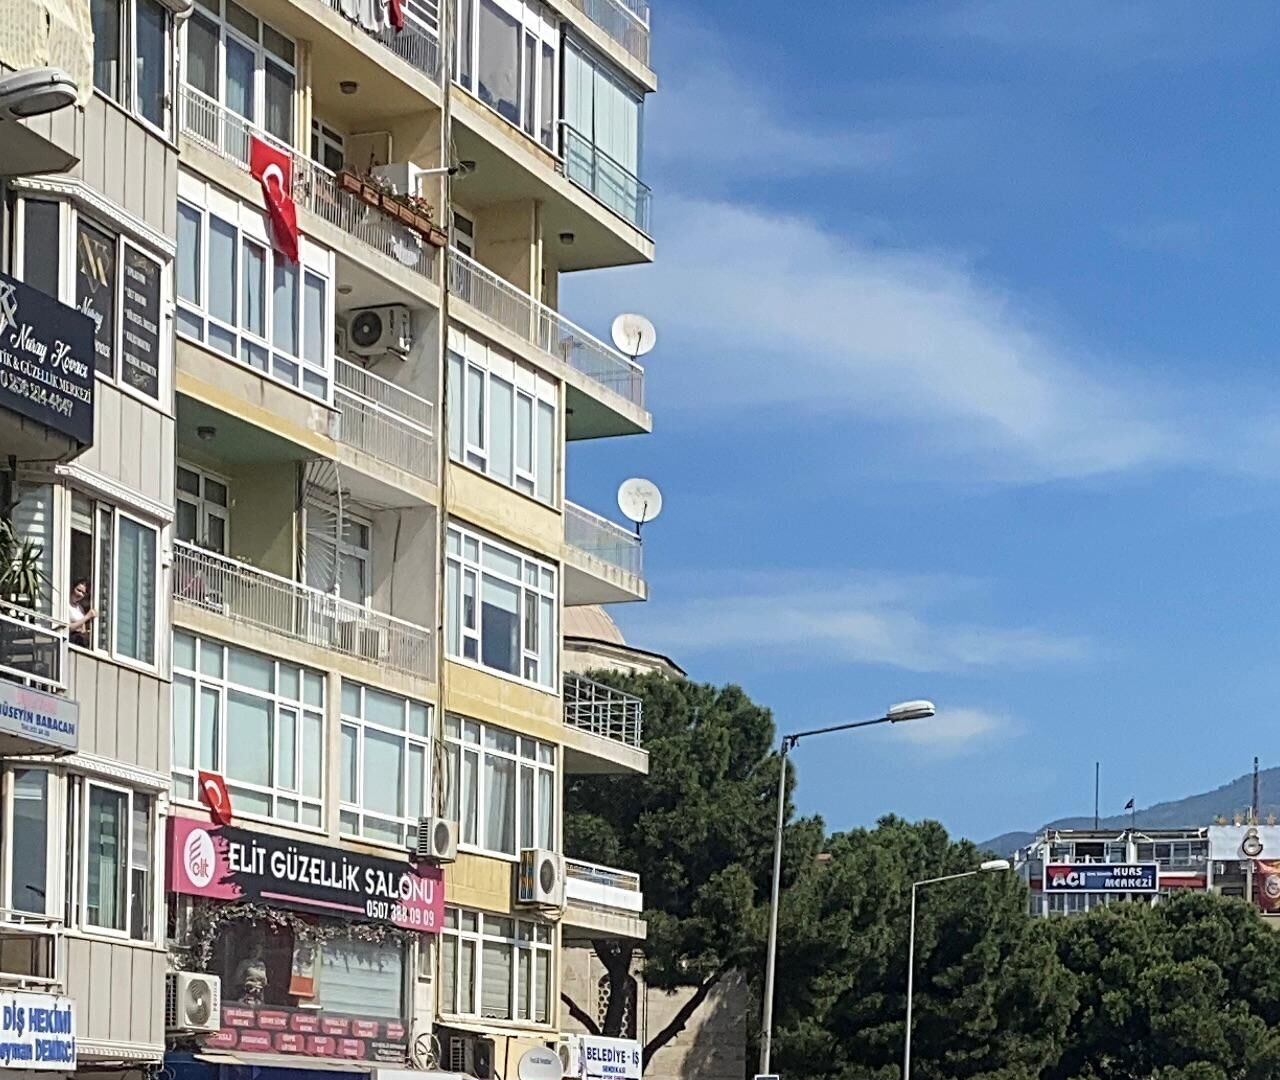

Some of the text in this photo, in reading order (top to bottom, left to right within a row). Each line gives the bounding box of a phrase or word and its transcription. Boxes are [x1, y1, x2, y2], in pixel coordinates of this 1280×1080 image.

[10, 324, 48, 363] Nuray
[20, 359, 60, 389] GÜZELLİK
[59, 378, 91, 404] MERKEZİ
[229, 839, 434, 904] ELİT GÜZELLİK SALONU
[1113, 867, 1142, 876] KURS
[367, 899, 389, 919] 0507
[409, 907, 421, 925] 09
[423, 910, 434, 927] 09
[3, 1000, 25, 1037] DİŞ
[586, 1046, 626, 1063] BELEDİYE
[632, 1049, 640, 1068] İŞ
